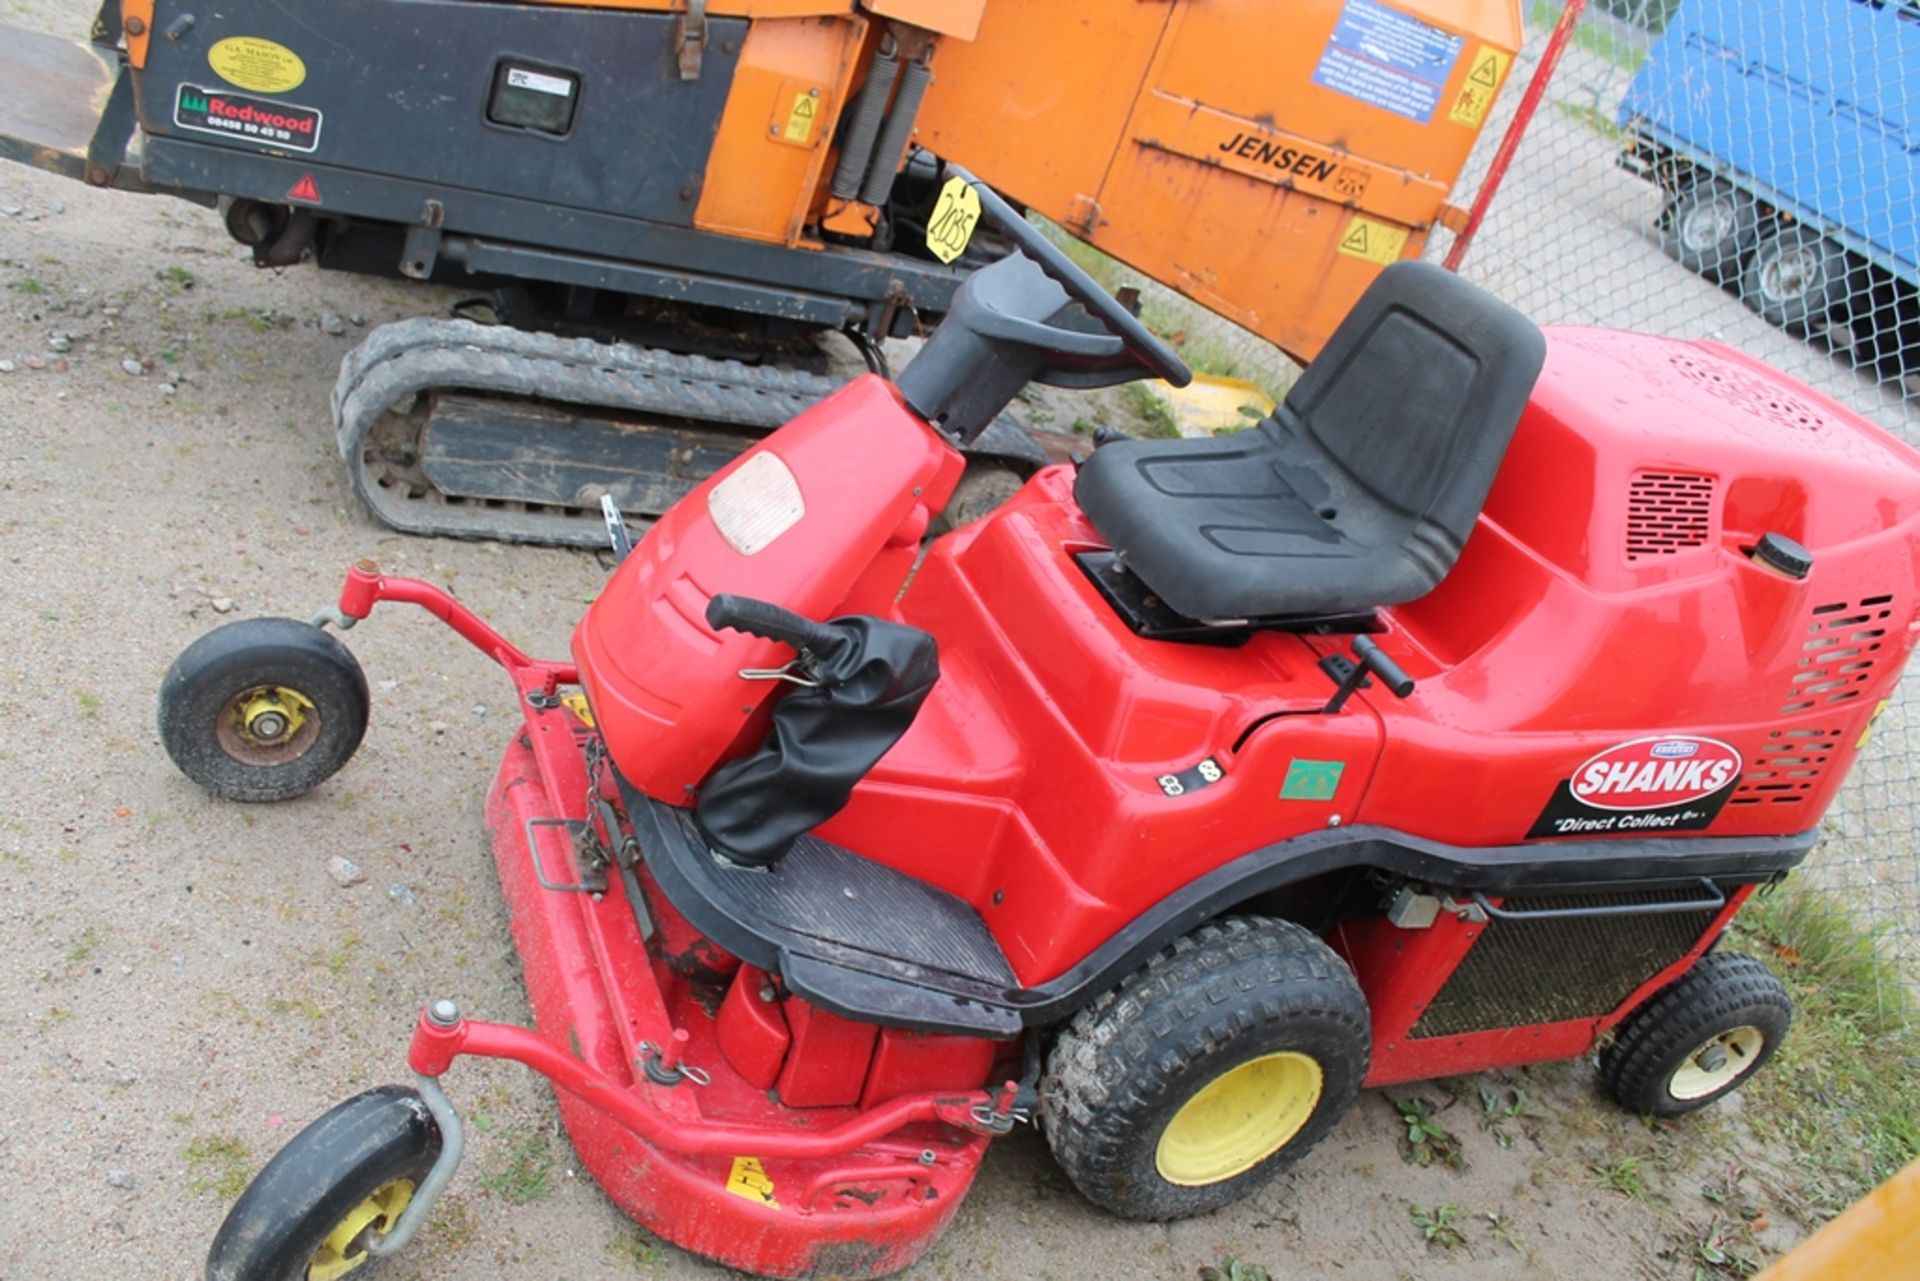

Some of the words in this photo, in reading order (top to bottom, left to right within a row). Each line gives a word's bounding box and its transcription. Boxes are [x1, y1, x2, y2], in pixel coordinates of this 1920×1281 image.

[209, 97, 313, 134] Redwood
[1219, 132, 1337, 182] JENSEN
[1576, 758, 1733, 796] SHANKS
[1617, 812, 1680, 829] Collect
